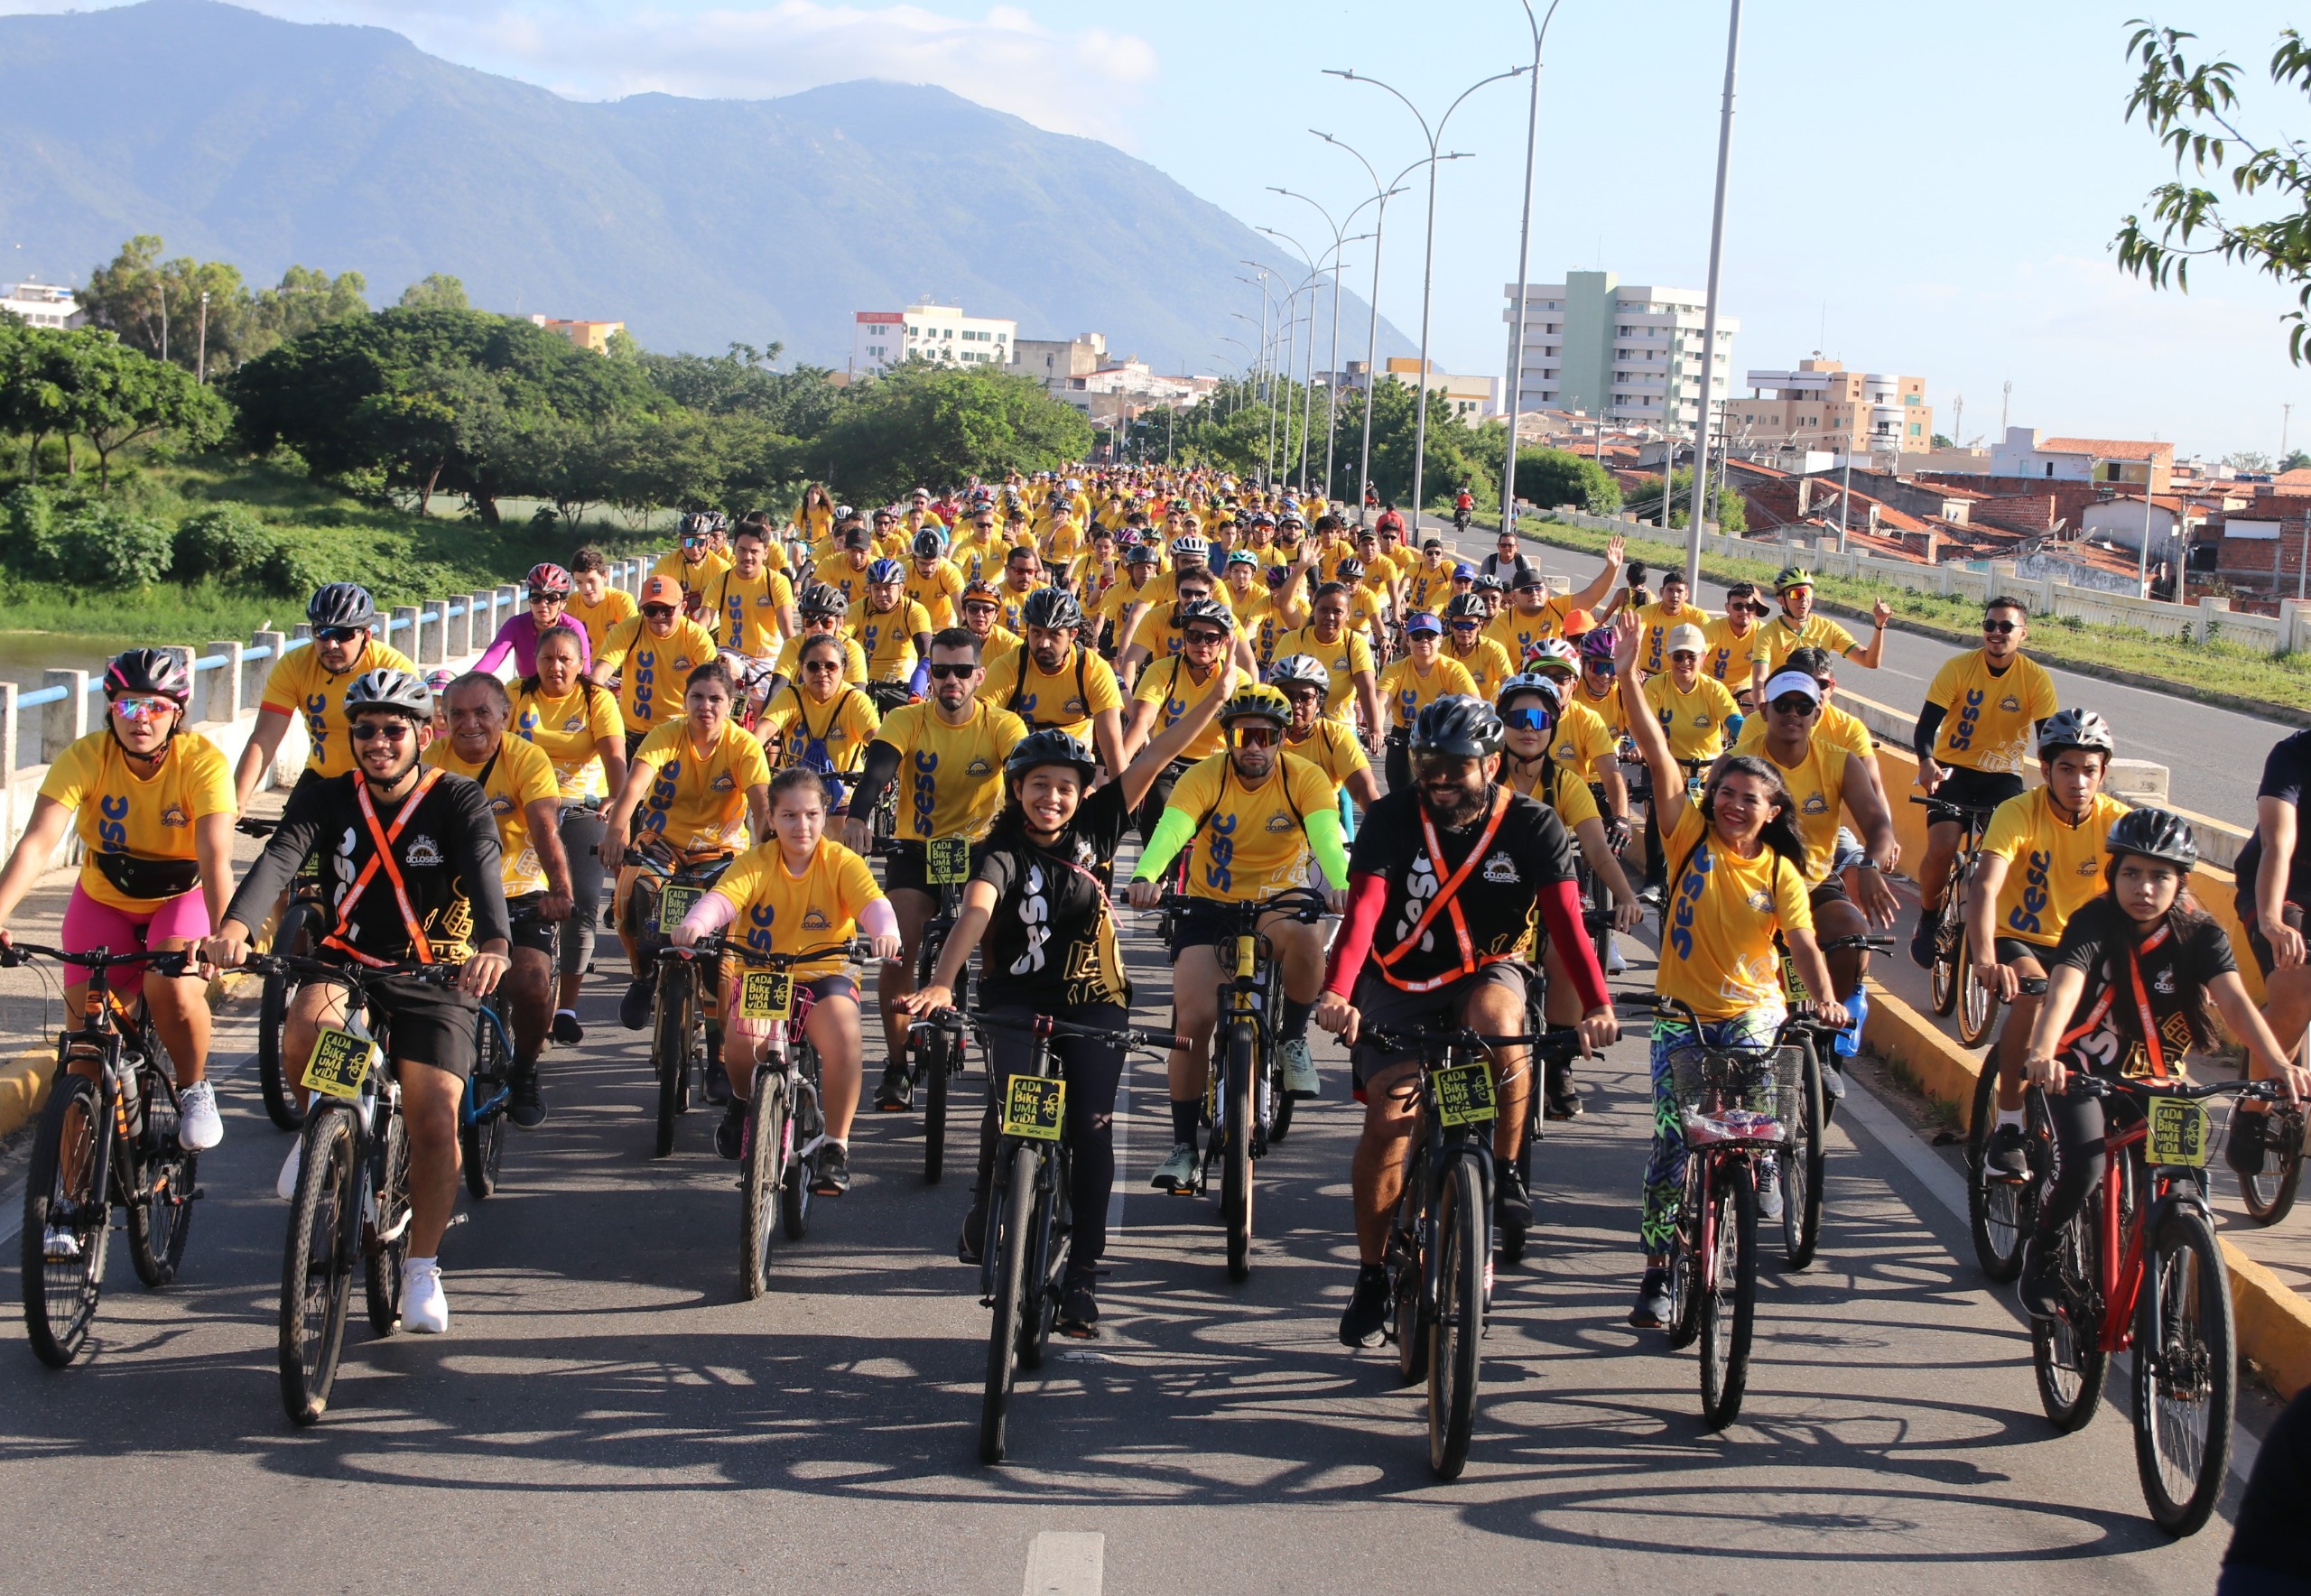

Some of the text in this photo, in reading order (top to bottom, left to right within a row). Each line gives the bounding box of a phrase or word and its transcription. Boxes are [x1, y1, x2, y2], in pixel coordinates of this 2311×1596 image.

[634, 650, 654, 720] Sesc
[1949, 688, 1983, 751] Sesc
[914, 750, 938, 838] Sesc
[932, 841, 951, 849] CADA
[1206, 812, 1237, 894] Sesc
[668, 890, 689, 900] CADA
[2009, 849, 2050, 933] Sesc
[1671, 844, 1713, 960] Sesc
[667, 908, 685, 916] UMA
[749, 975, 773, 985] CADA
[749, 993, 769, 1001] UMA
[325, 1035, 351, 1050] CADA
[319, 1057, 342, 1072] UMA
[1441, 1071, 1468, 1083] CADA
[1015, 1081, 1042, 1093] CADA
[1445, 1091, 1469, 1103] UMA
[1014, 1104, 1037, 1115] UMA
[2157, 1109, 2183, 1120] CADA
[2158, 1133, 2179, 1143] UMA
